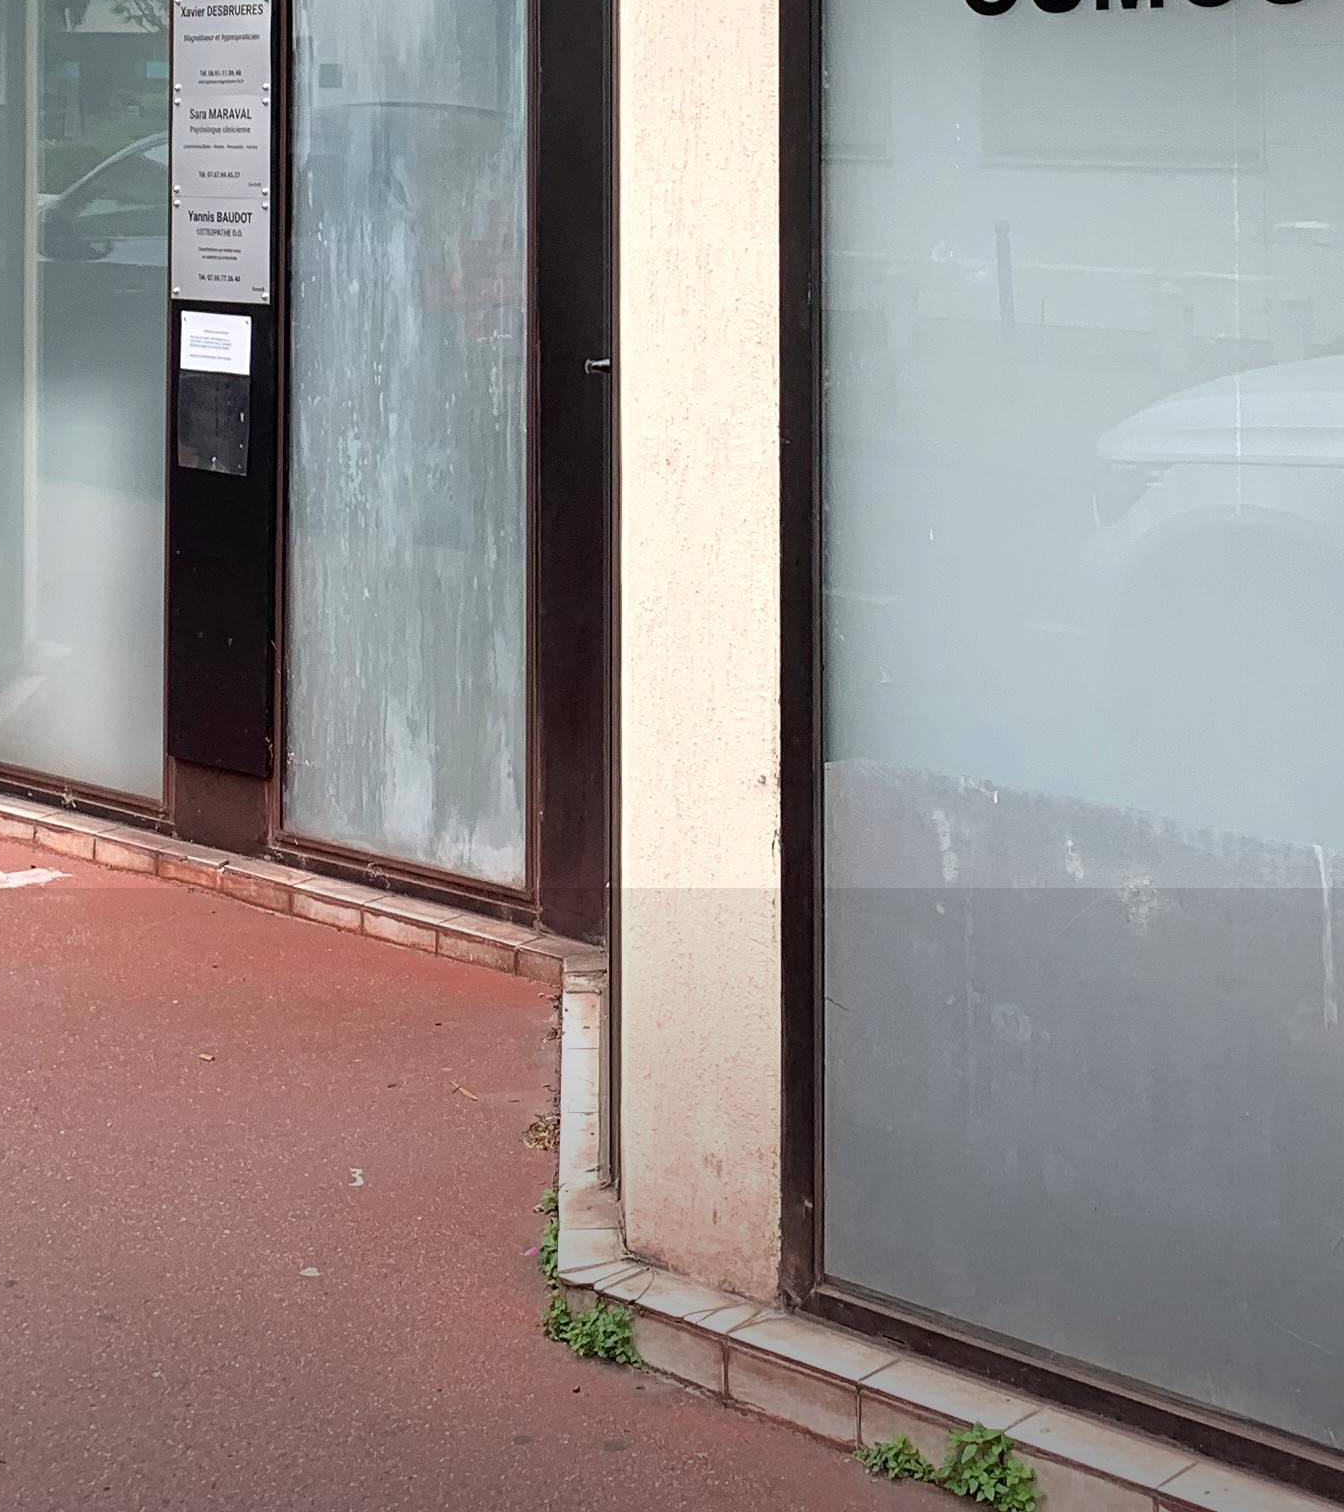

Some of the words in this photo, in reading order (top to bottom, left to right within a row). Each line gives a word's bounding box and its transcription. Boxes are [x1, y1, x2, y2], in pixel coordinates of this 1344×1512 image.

[181, 6, 205, 18] Xavier
[190, 108, 207, 119] Sara
[208, 109, 252, 119] MARAVAL
[188, 211, 215, 222] Yannis
[216, 212, 253, 223] BAUDOT
